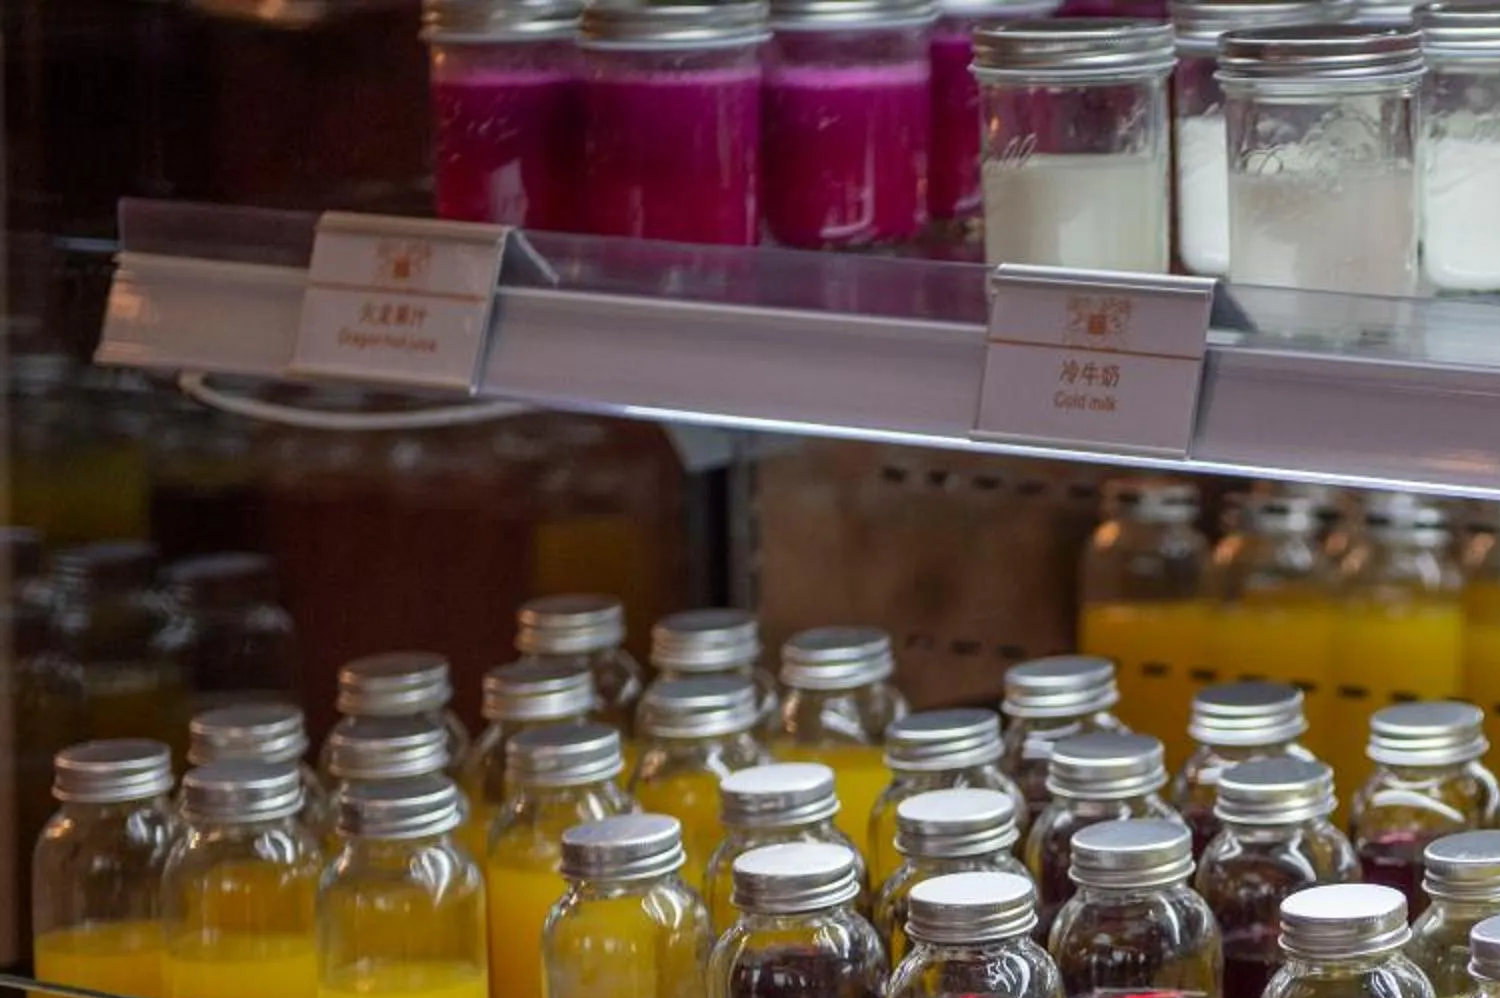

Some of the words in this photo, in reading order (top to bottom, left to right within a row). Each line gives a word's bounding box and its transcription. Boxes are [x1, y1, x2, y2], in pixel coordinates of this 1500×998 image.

[1059, 359, 1121, 388] 冷牛奶
[1054, 391, 1085, 411] Cold
[1088, 394, 1117, 412] milk
